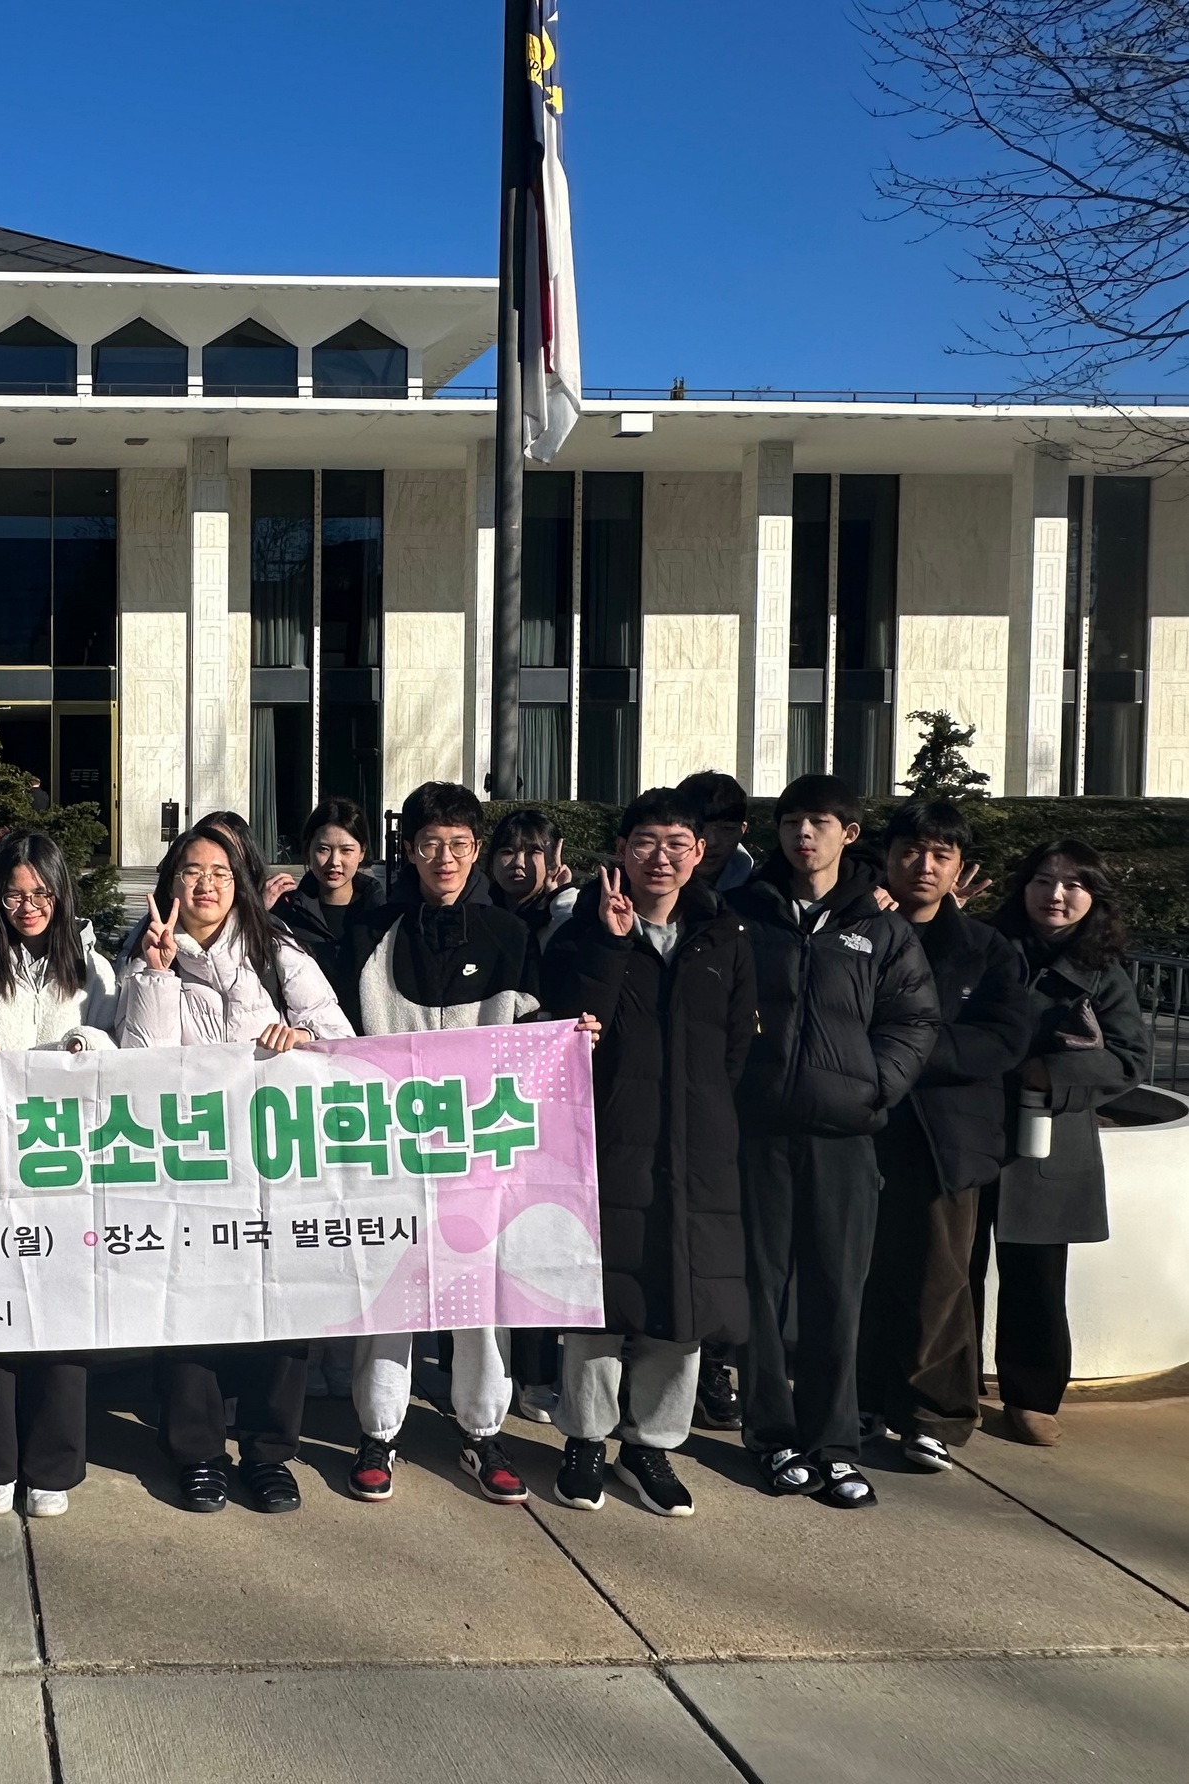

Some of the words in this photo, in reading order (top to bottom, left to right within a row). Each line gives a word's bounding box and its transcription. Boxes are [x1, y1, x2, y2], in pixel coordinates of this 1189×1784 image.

[17, 1091, 229, 1188] 청소년
[250, 1077, 535, 1178] 어학연수
[103, 1224, 166, 1255] 장소
[212, 1219, 273, 1250] 미국
[291, 1215, 419, 1248] 벌링턴시
